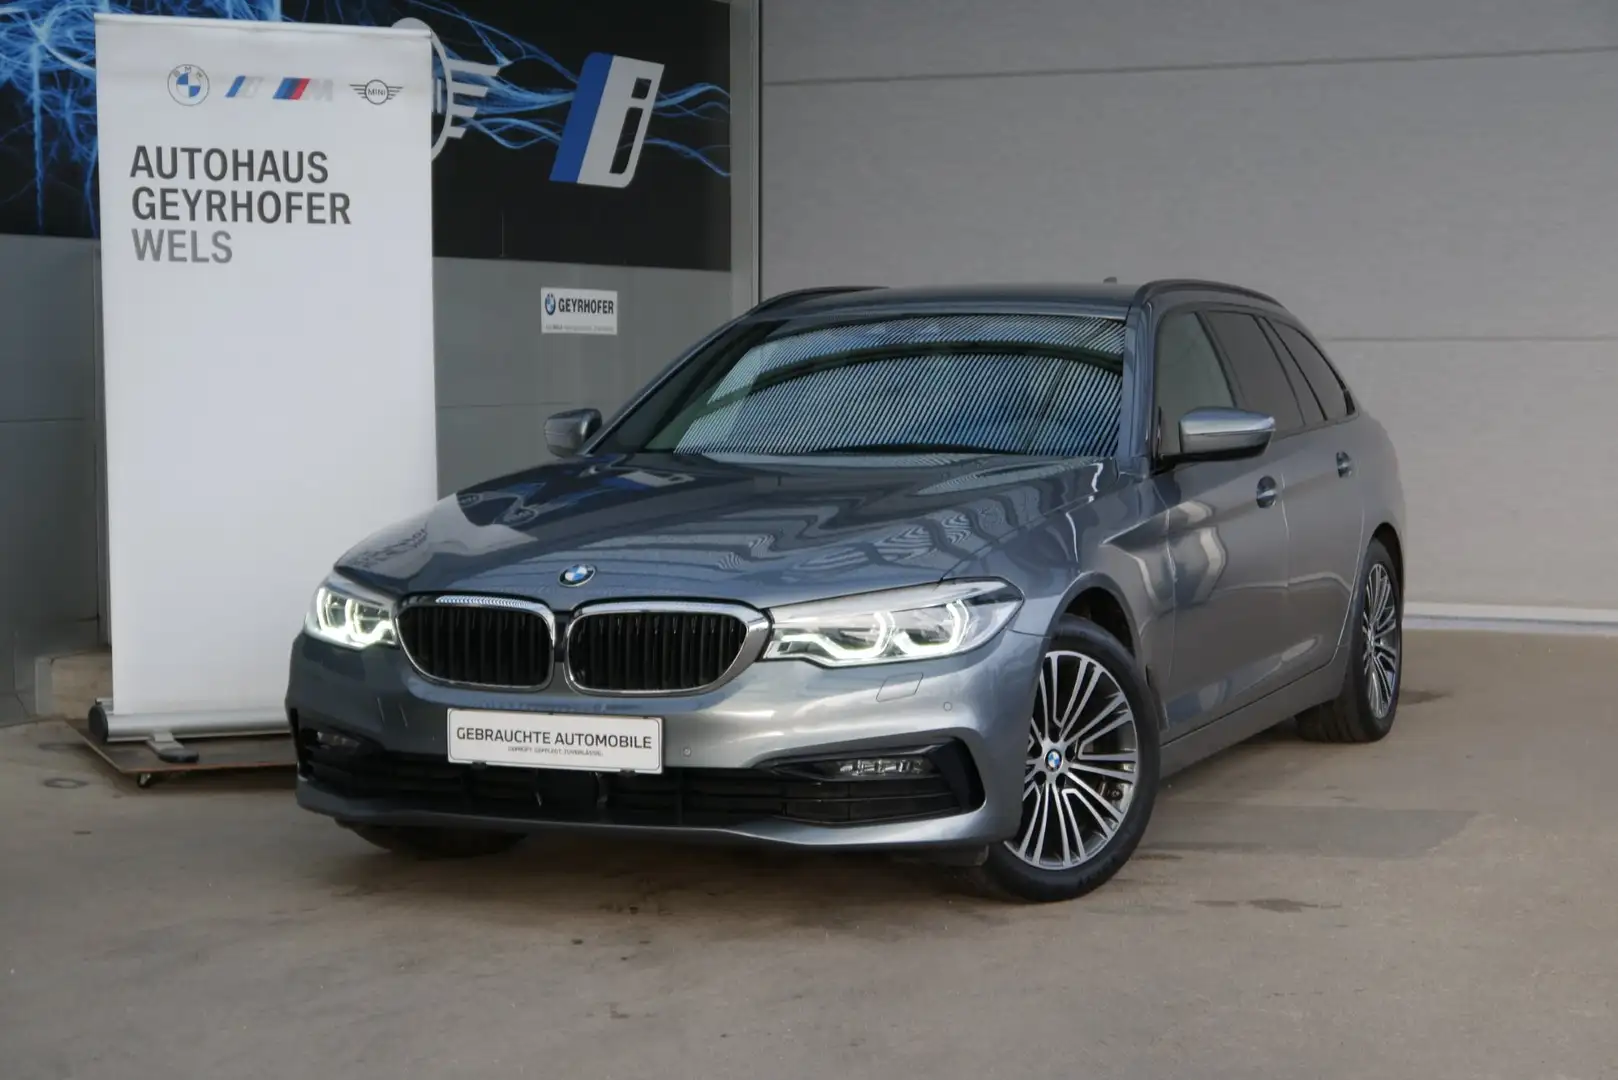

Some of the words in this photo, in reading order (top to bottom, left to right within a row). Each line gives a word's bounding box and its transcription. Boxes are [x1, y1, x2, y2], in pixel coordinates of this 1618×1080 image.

[367, 87, 386, 97] MINI
[130, 145, 329, 184] AUTOHAUS
[131, 186, 351, 225] GEYRHOFER
[131, 228, 233, 264] WELS
[558, 298, 614, 314] GEYRHOFER
[456, 726, 551, 745] GEBRAUCHTE
[554, 732, 652, 750] AUTOMOBILE
